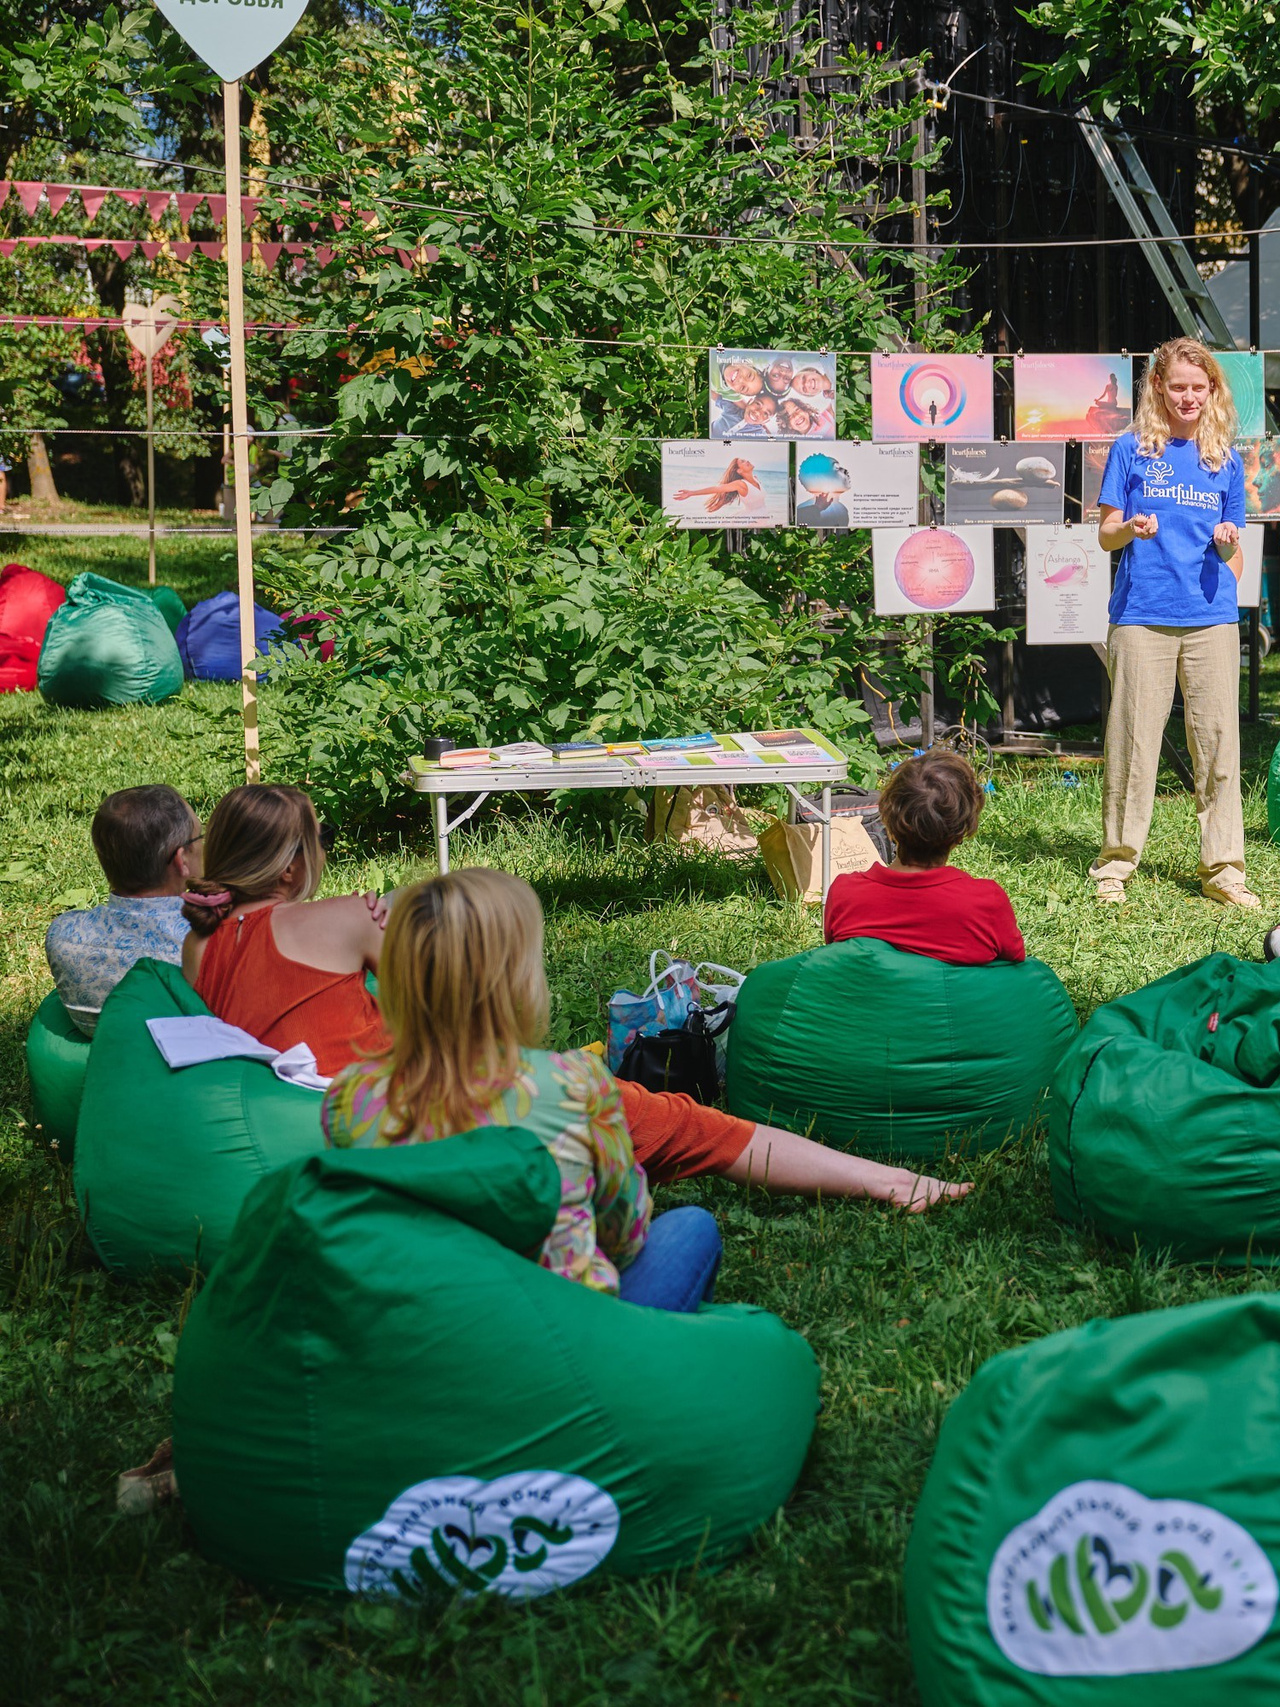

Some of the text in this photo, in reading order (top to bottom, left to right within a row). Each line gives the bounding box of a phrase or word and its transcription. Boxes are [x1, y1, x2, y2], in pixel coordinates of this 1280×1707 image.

[716, 355, 753, 364] heartfulness
[877, 360, 912, 370] heartfulness
[1020, 361, 1056, 370] heartfulness
[669, 447, 705, 457] heartfulness
[879, 448, 913, 457] heartfulness
[952, 448, 986, 458] heartfulness
[1143, 480, 1220, 505] heartfulness
[1182, 500, 1206, 509] advancing
[1047, 555, 1081, 565] Ashtanga
